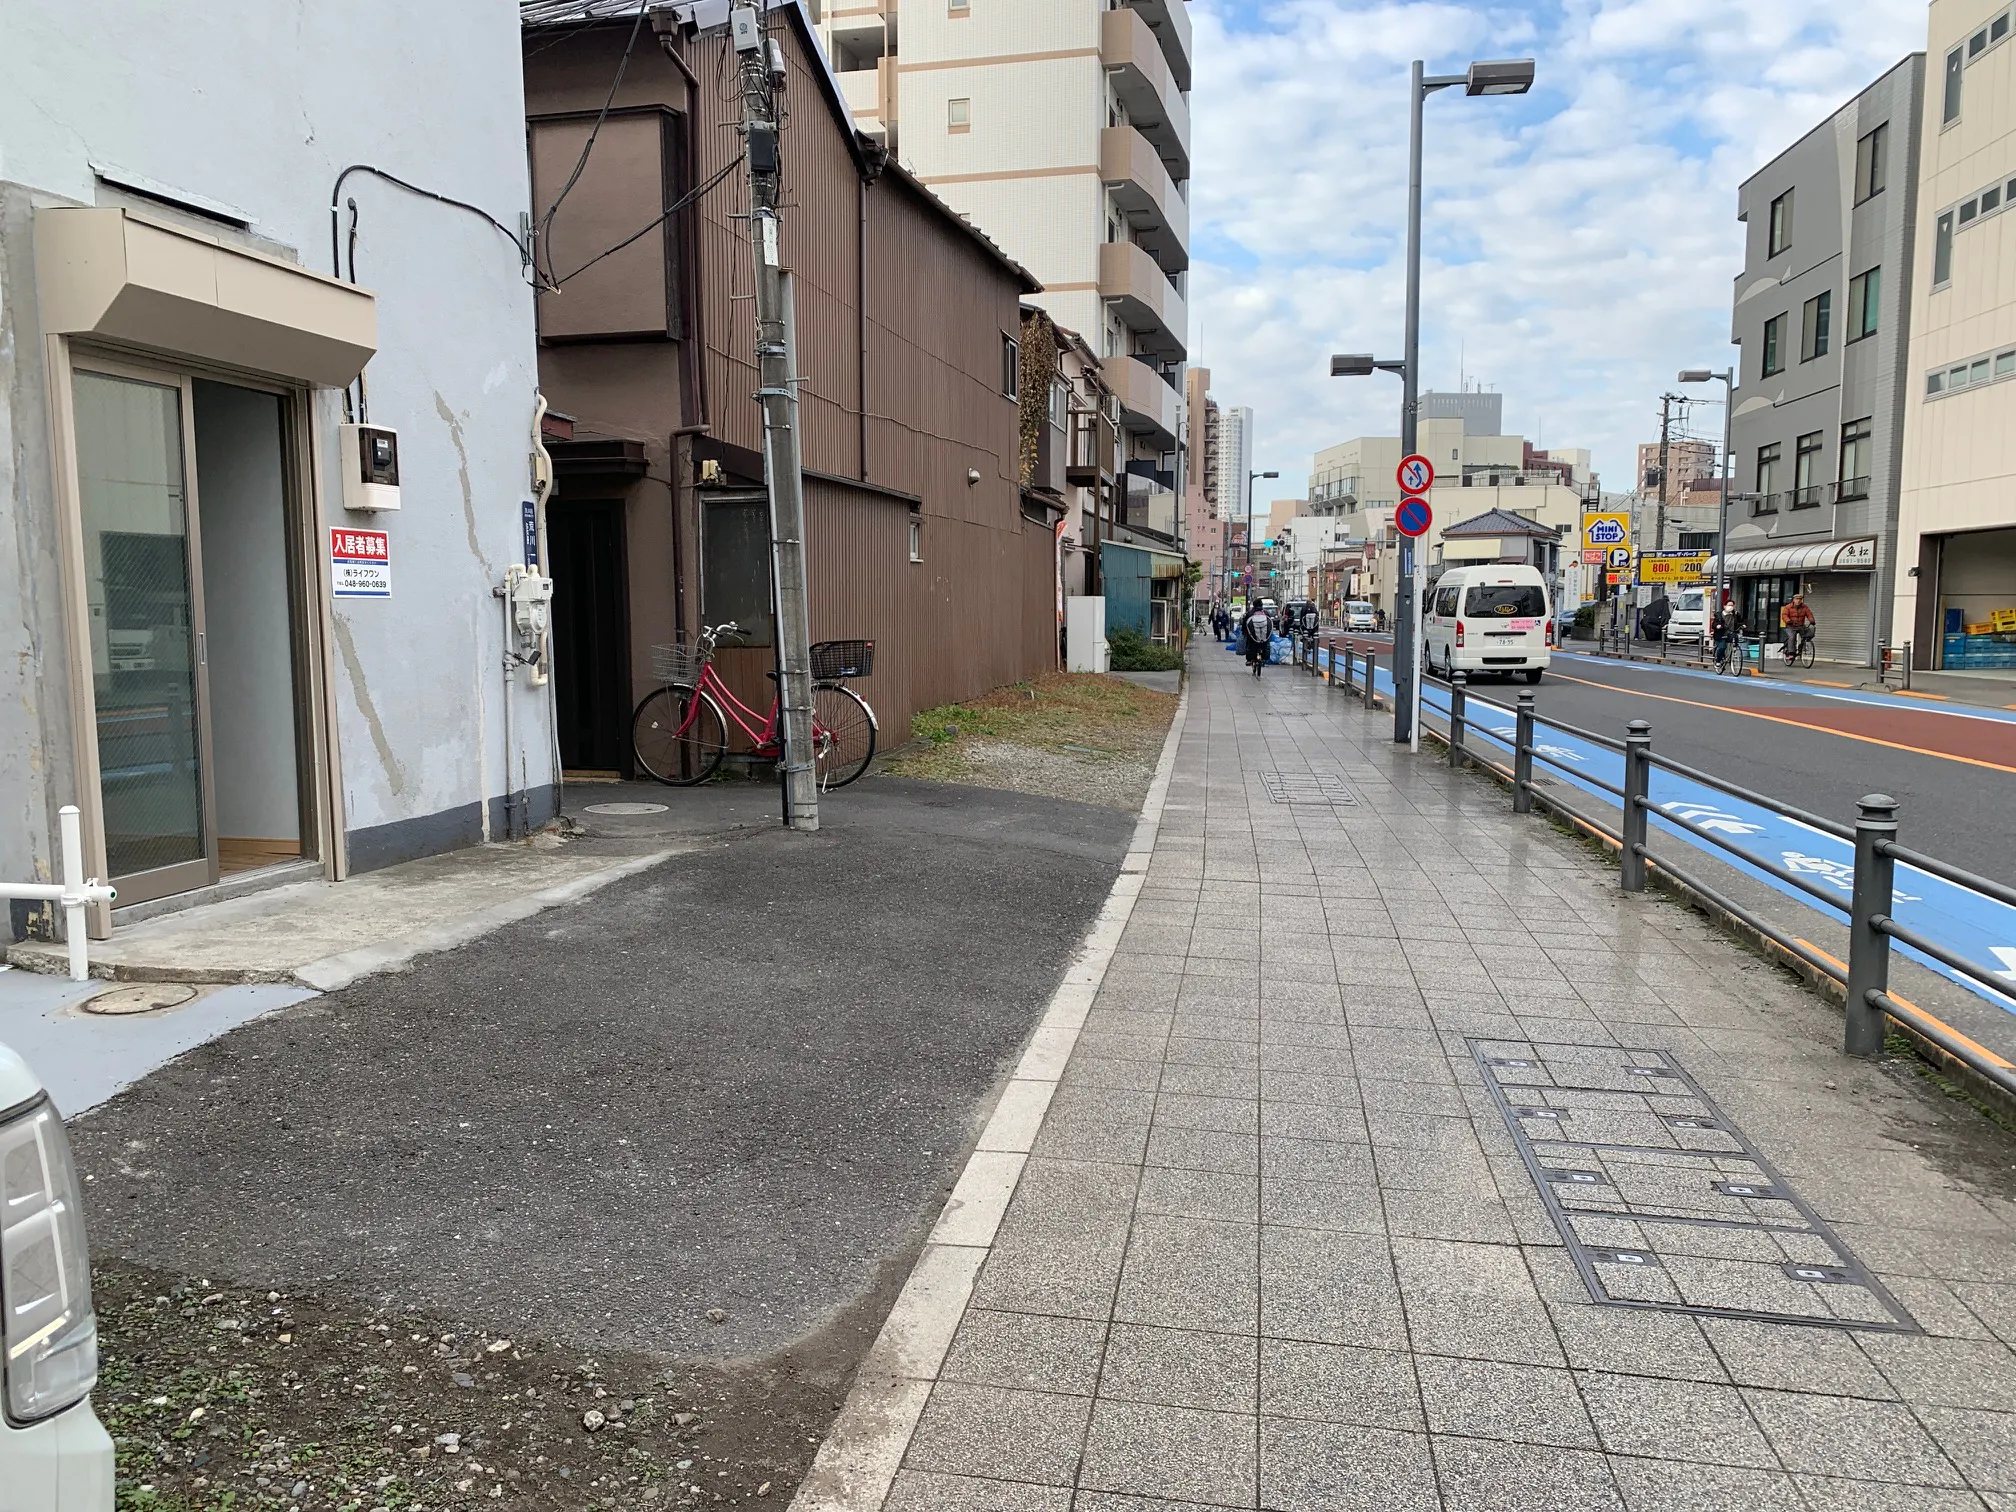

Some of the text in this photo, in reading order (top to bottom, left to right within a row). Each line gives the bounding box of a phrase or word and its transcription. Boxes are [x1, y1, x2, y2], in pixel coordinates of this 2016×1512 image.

[1597, 525, 1617, 533] MINI
[334, 534, 386, 556] 入居者募集
[1614, 549, 1628, 566] P
[1652, 563, 1670, 573] 800
[1684, 563, 1702, 572] 200
